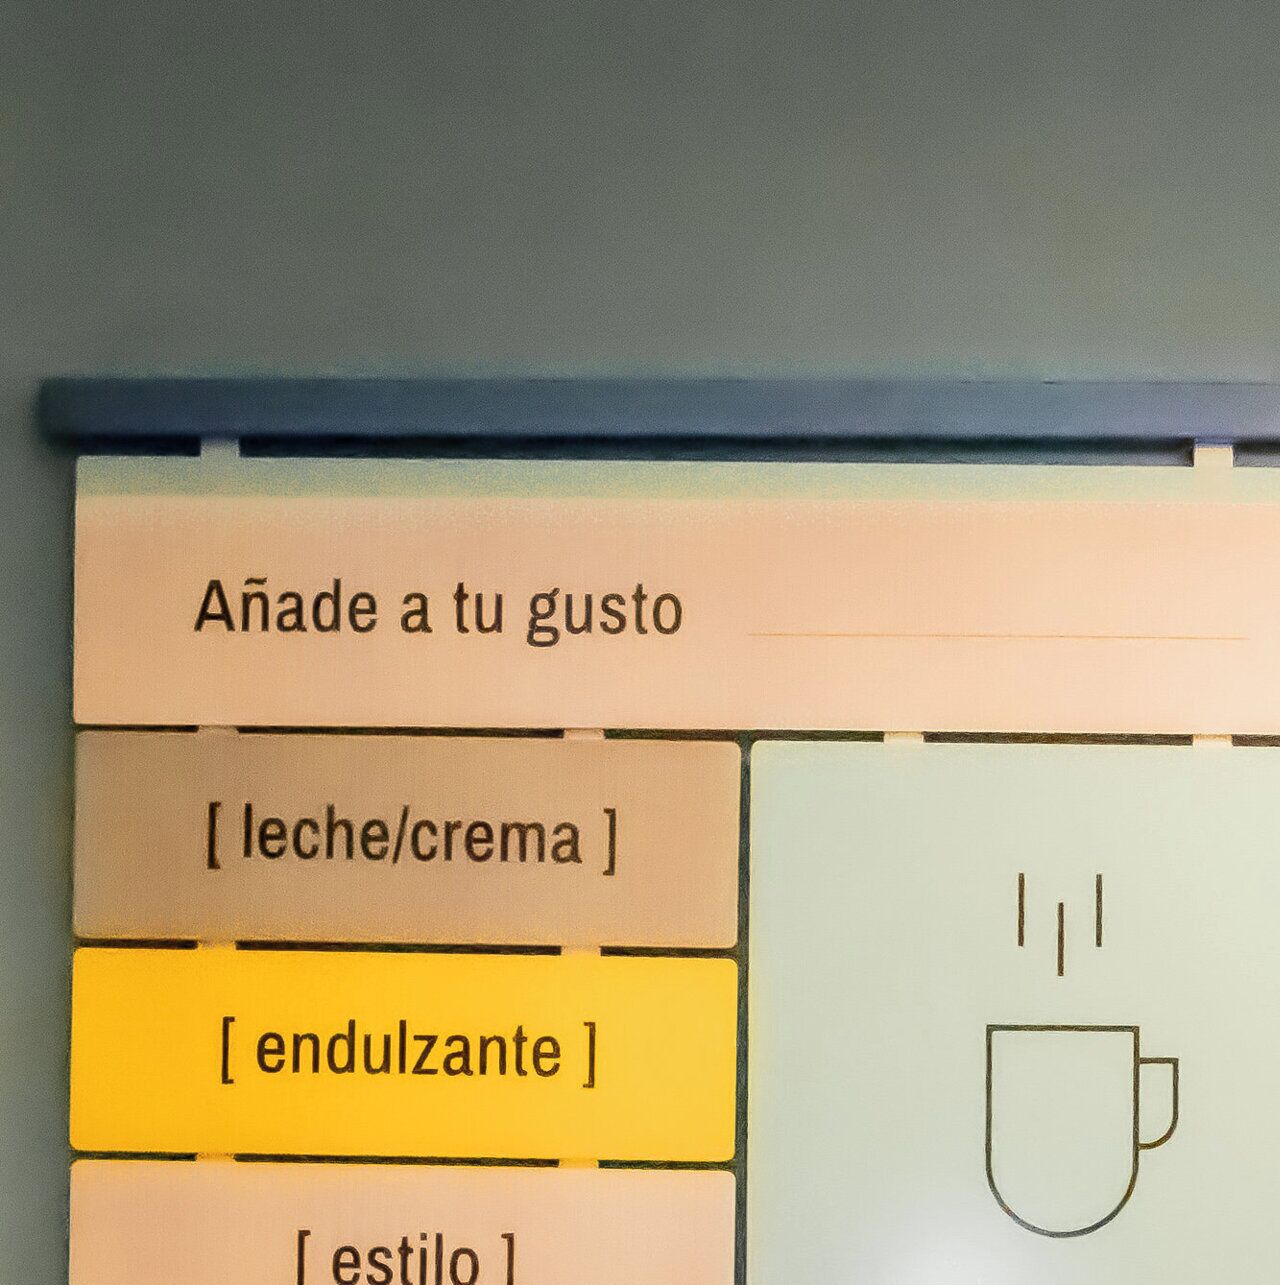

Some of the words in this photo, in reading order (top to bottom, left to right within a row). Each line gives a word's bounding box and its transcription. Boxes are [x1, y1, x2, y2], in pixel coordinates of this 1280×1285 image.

[193, 577, 379, 634] Añade
[400, 592, 434, 634] a
[453, 581, 504, 634] tu
[526, 583, 684, 648] gusto
[243, 802, 584, 864] leche/crema
[256, 1019, 562, 1078] endulzante
